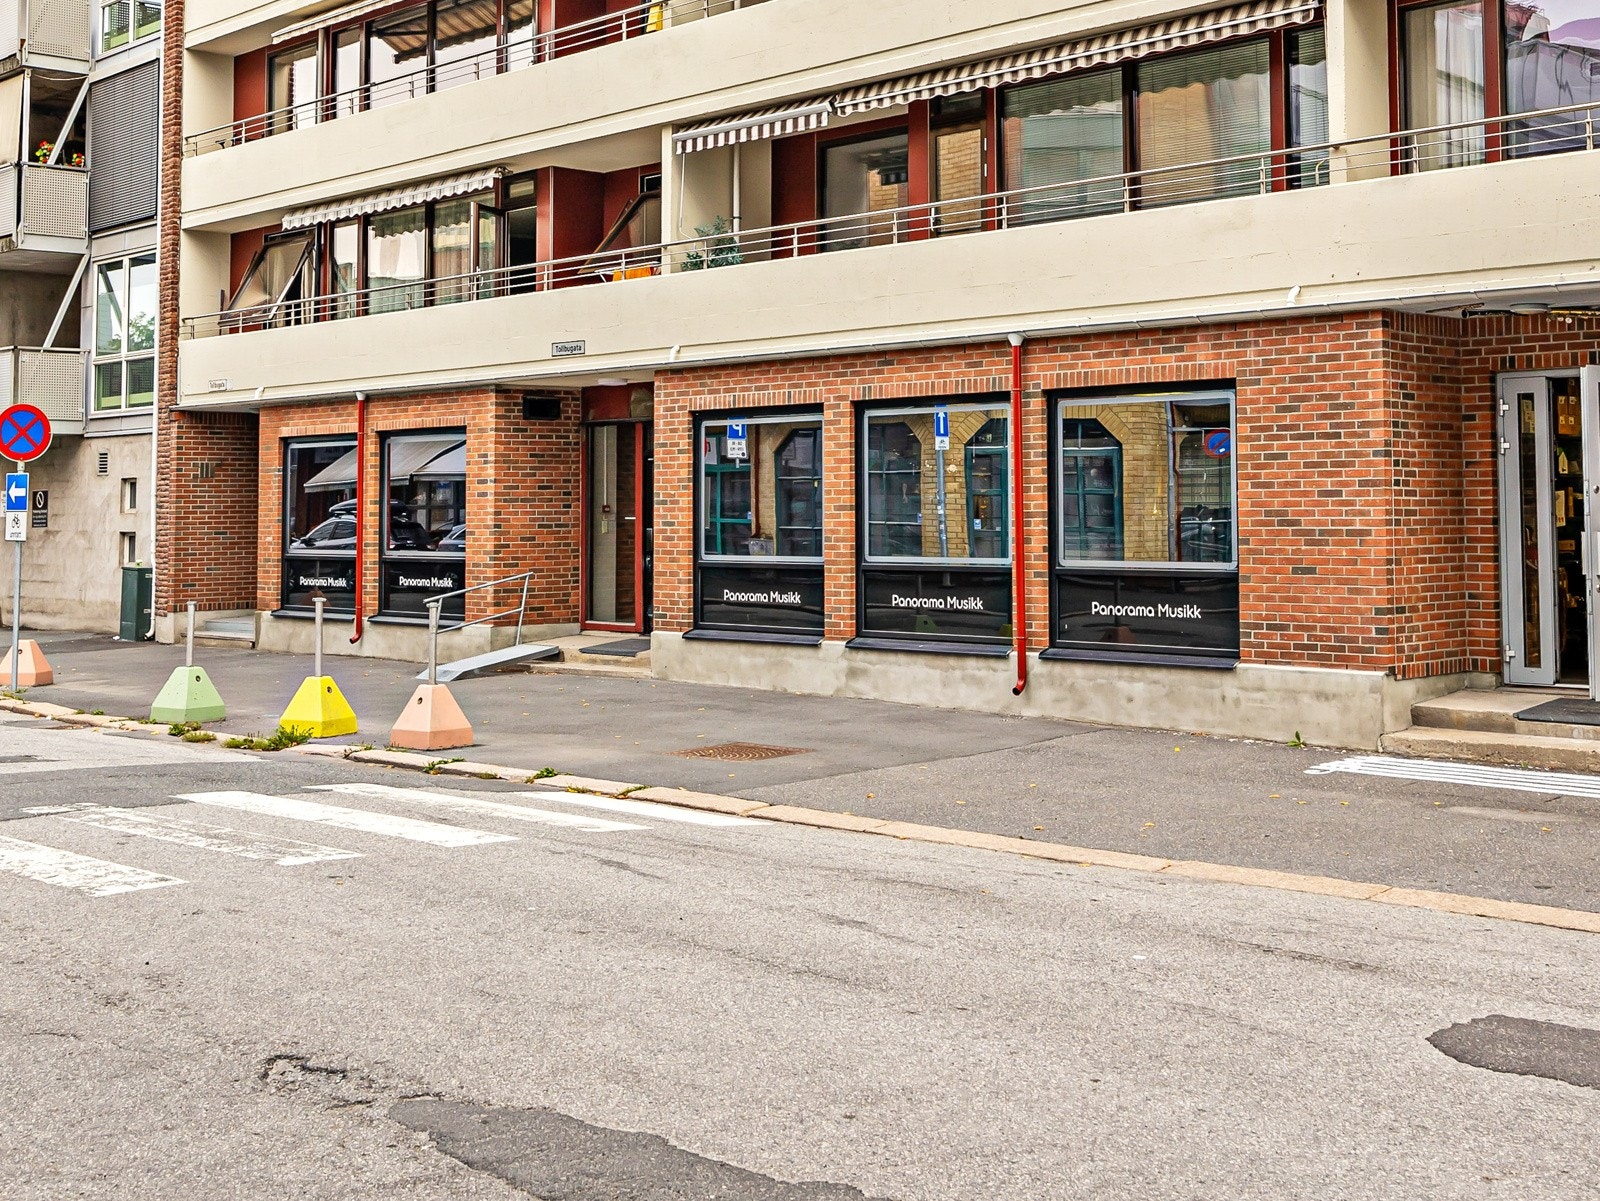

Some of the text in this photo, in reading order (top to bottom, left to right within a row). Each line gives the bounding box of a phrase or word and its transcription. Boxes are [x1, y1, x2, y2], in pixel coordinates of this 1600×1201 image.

[554, 344, 582, 354] Tollbugata
[300, 576, 346, 588] Panorama Musikk
[399, 576, 453, 588] Panorama Musikk
[723, 588, 801, 604] Panorama Musikk
[891, 594, 984, 610] Panorama Musikk
[1091, 601, 1202, 619] Panorama Musikk
